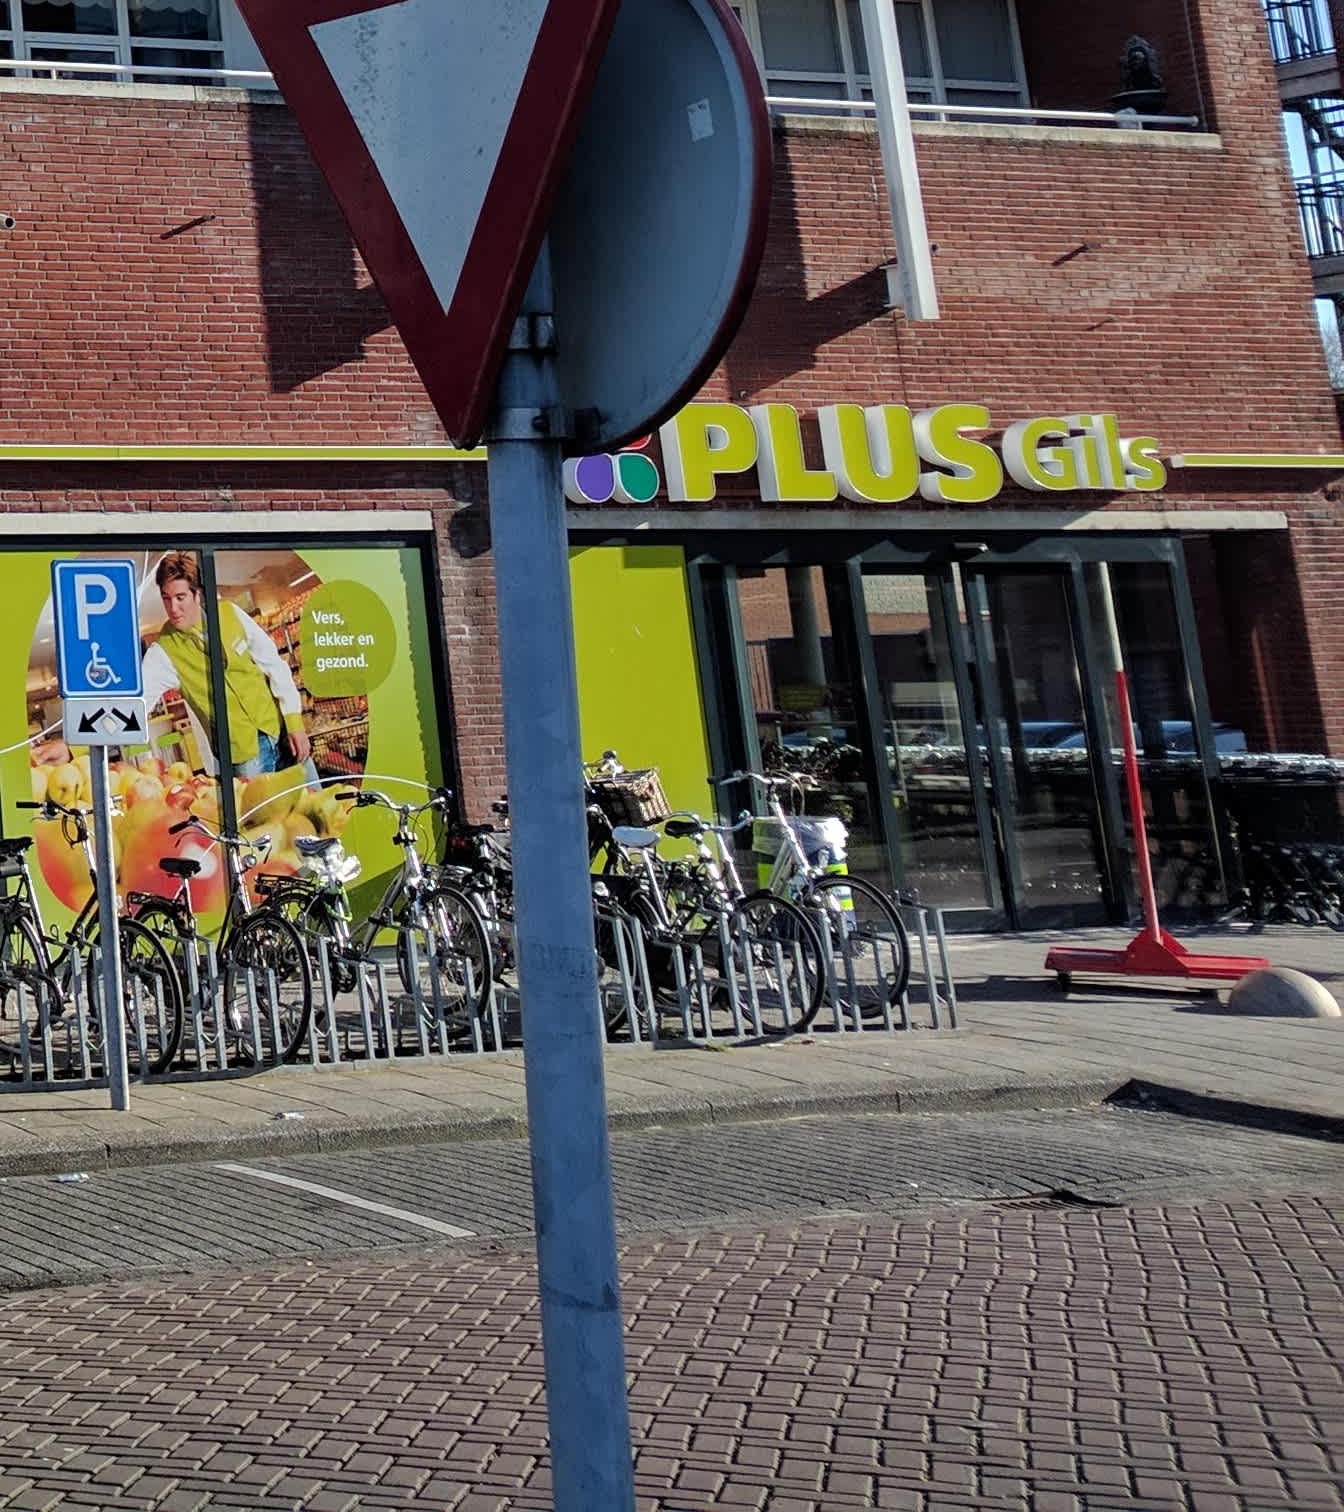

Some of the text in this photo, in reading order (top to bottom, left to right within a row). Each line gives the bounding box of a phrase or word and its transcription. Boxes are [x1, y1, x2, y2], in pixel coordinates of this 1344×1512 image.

[659, 402, 1167, 503] PLUS Gils
[74, 573, 118, 641] P
[311, 609, 345, 626] Vers,
[314, 631, 375, 647] lekker en
[315, 653, 369, 672] gezond.
